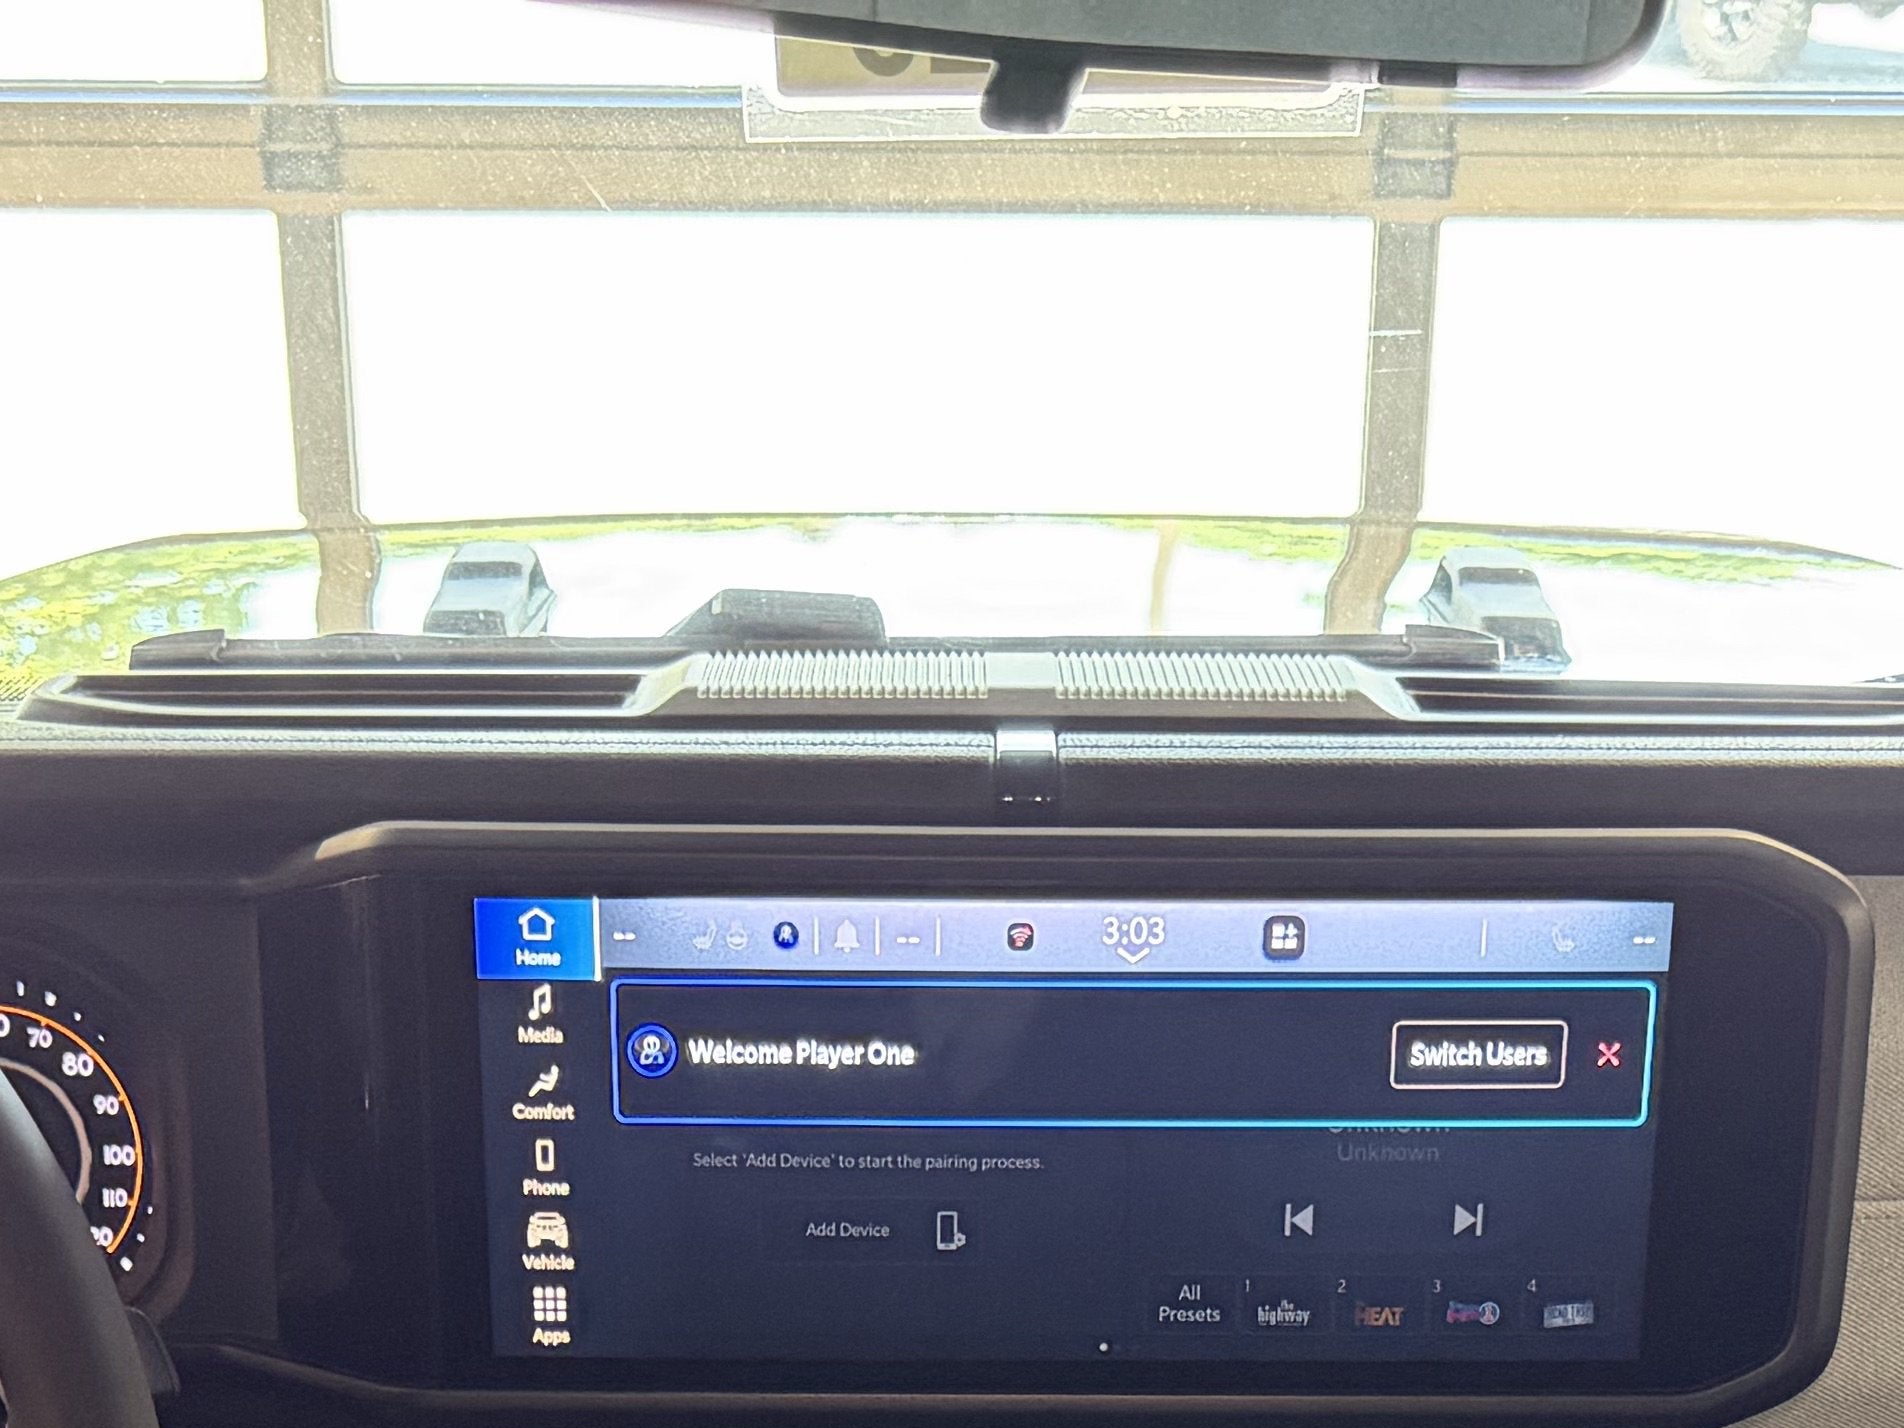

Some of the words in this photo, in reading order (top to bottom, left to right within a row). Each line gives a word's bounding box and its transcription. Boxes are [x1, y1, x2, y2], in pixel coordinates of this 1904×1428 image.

[1101, 916, 1166, 946] 3:03
[515, 949, 561, 967] Home
[26, 1026, 53, 1049] 70
[518, 1027, 564, 1045] Media
[688, 1038, 792, 1066] Welcome
[797, 1038, 865, 1068] Player
[867, 1042, 915, 1066] One
[1410, 1041, 1483, 1067] Switch
[1485, 1042, 1548, 1067] Users
[61, 1051, 94, 1077] 80
[93, 1094, 119, 1116] 90
[512, 1102, 575, 1121] Comfort
[102, 1144, 136, 1166] 100
[1336, 1142, 1440, 1162] Unknown
[692, 1153, 738, 1169] Select
[742, 1153, 776, 1169] 'Add
[779, 1153, 835, 1169] Device'
[837, 1155, 855, 1170] to
[858, 1155, 893, 1170] start
[897, 1154, 922, 1170] the
[925, 1154, 978, 1174] pairing
[981, 1156, 1045, 1174] process.
[102, 1188, 128, 1208] 110
[521, 1179, 570, 1197] Phone
[805, 1222, 837, 1238] Add
[839, 1222, 890, 1238] Device
[521, 1254, 575, 1272] Vehicle
[1178, 1284, 1201, 1301] All
[1336, 1278, 1347, 1293] 2
[1432, 1278, 1442, 1293] 3
[1526, 1278, 1538, 1293] 4
[1158, 1304, 1221, 1324] Presets
[1257, 1305, 1310, 1328] highway
[1355, 1306, 1404, 1326] HEAT
[532, 1329, 571, 1348] Apps
